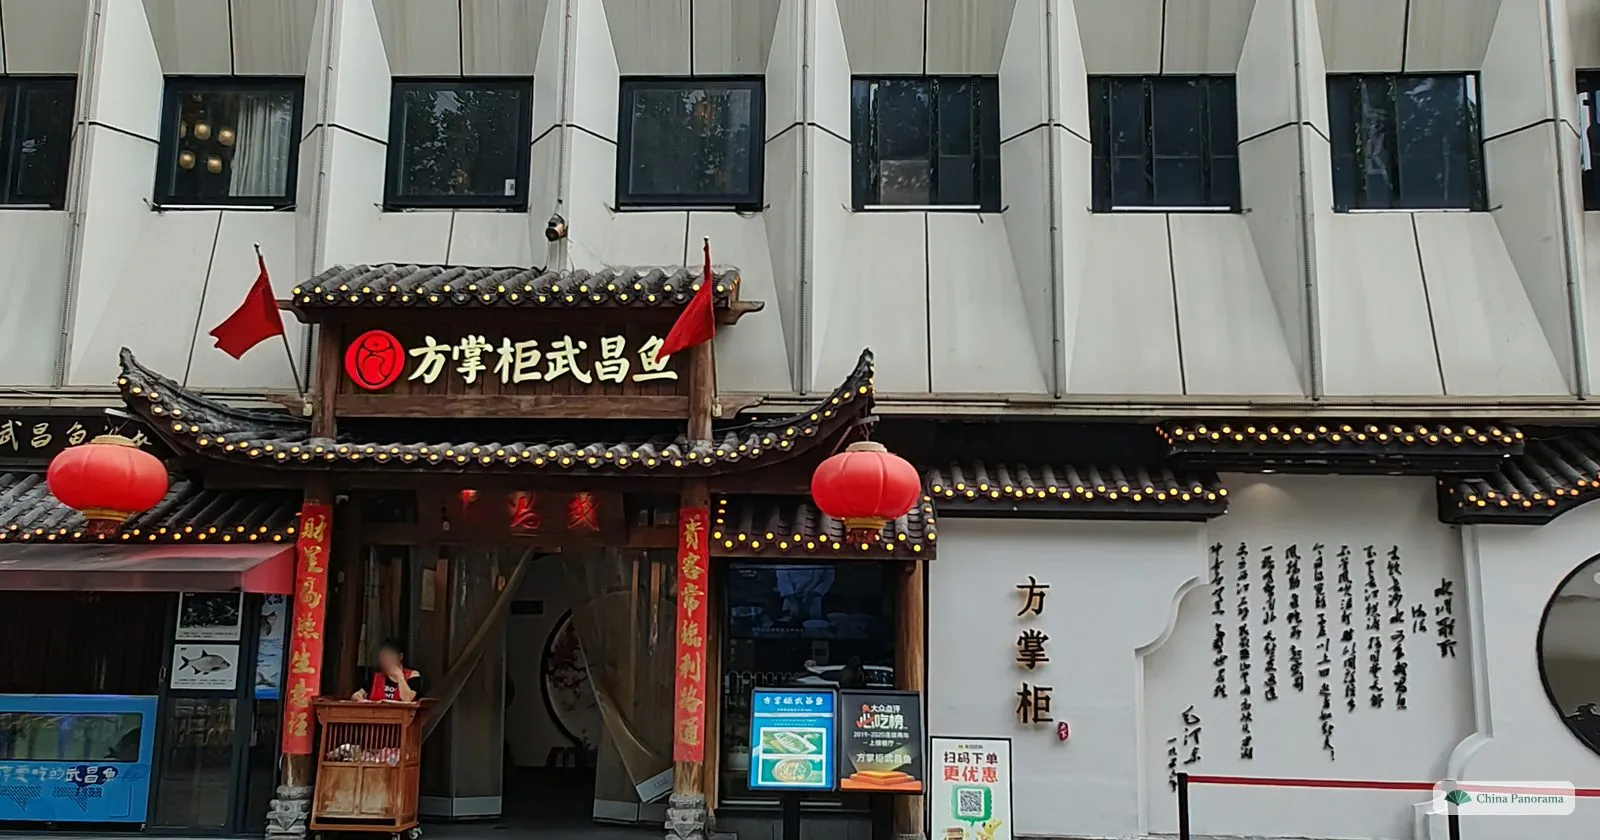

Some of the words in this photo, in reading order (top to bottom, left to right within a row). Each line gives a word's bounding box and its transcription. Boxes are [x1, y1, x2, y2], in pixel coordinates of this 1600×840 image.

[407, 334, 678, 384] 方掌柜武昌鱼
[1016, 576, 1053, 723] 方掌柜
[870, 704, 901, 713] 大众点评
[856, 753, 912, 764] 方掌柜武昌鱼
[944, 751, 998, 765] 扫码下单
[944, 765, 998, 783] 更优惠
